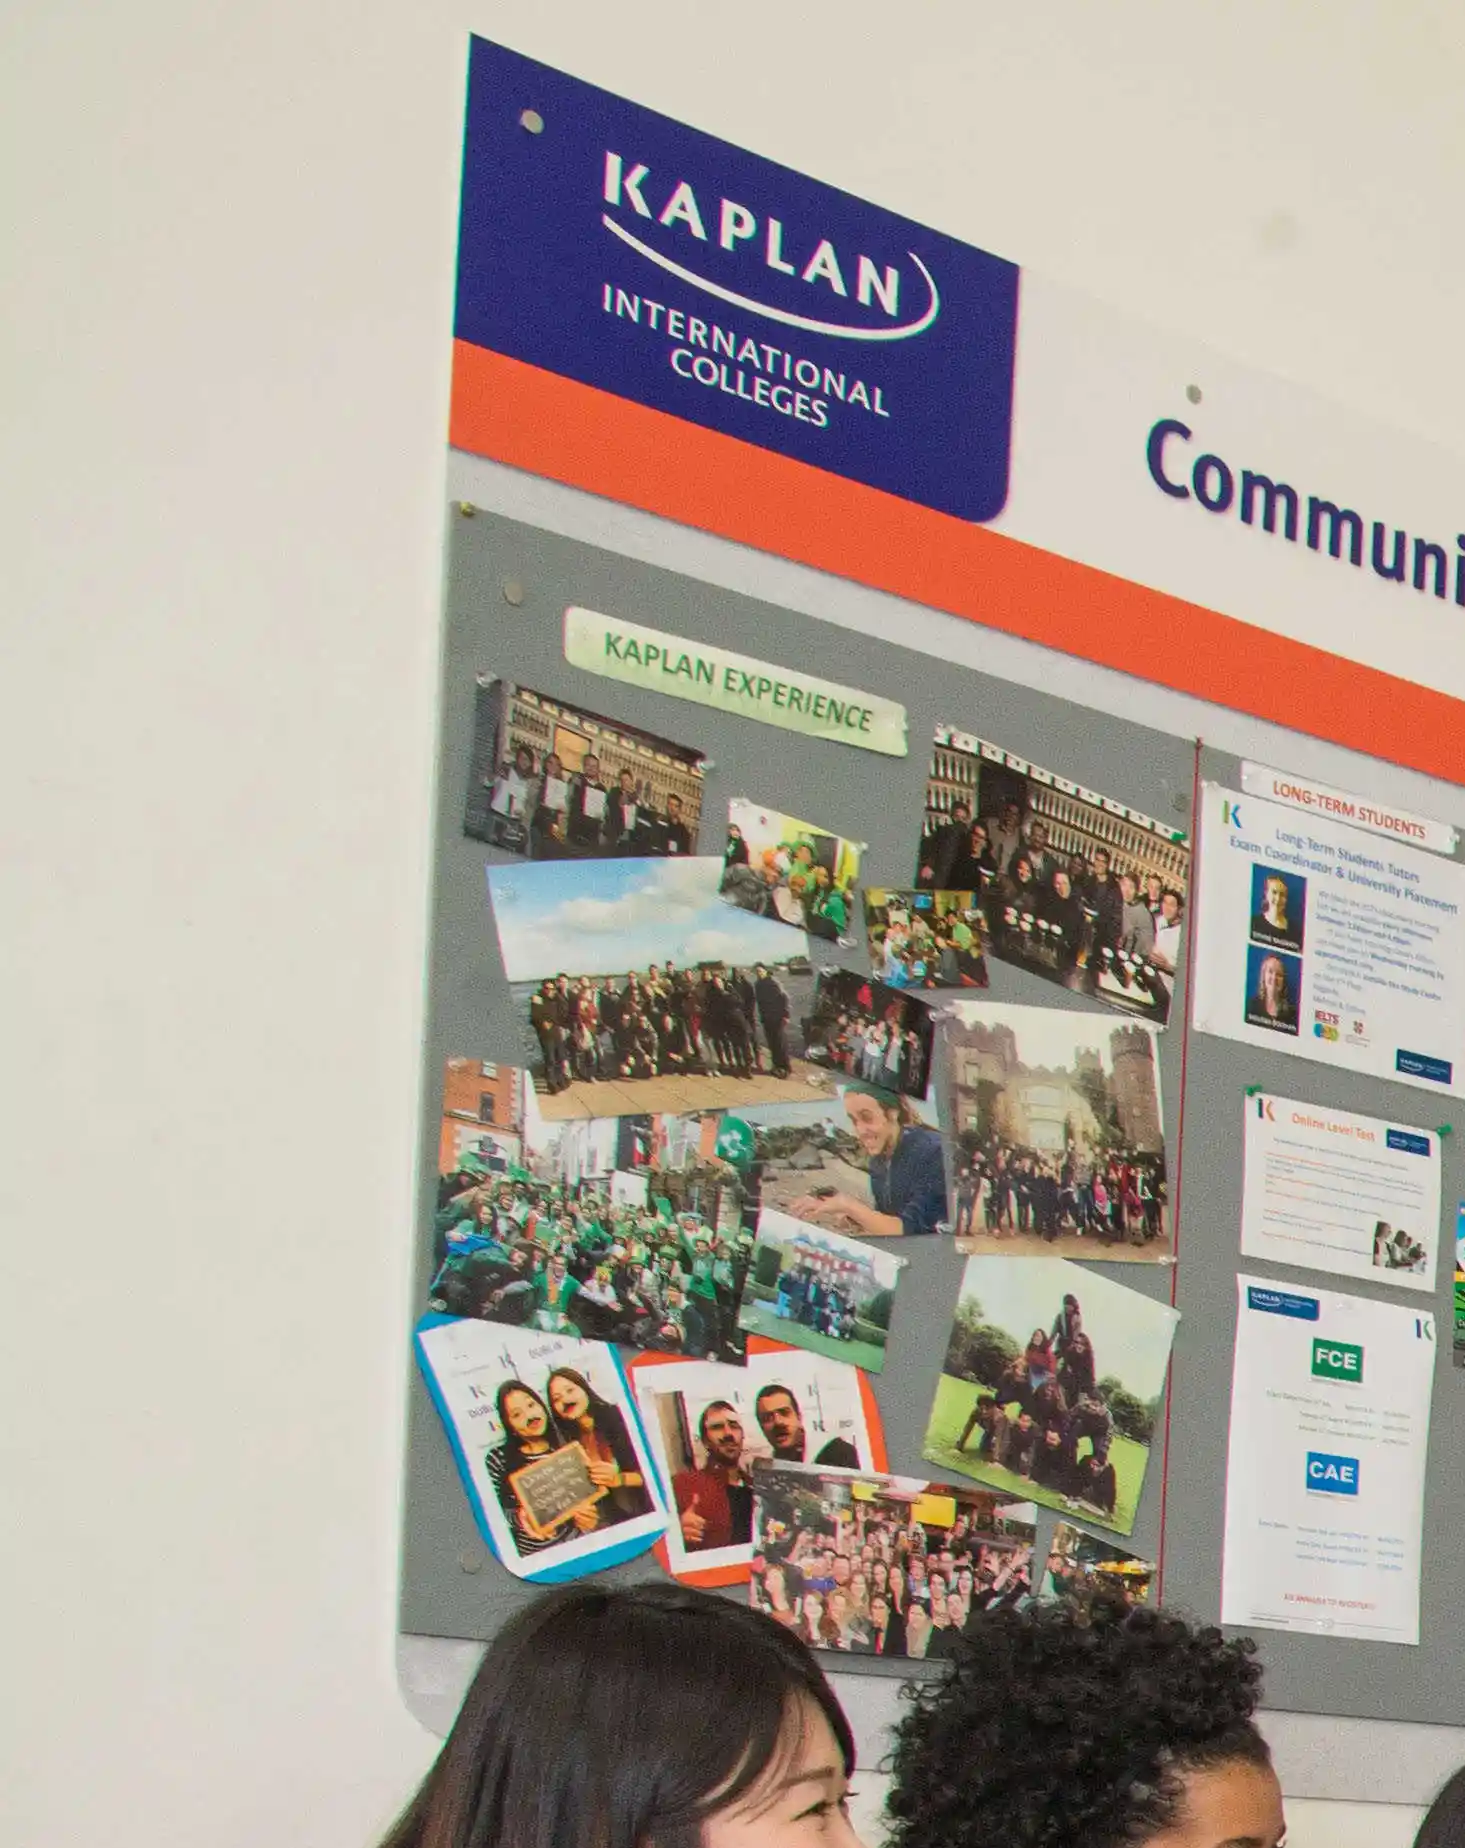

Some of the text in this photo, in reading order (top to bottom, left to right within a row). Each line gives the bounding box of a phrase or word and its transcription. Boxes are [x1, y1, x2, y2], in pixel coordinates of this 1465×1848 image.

[602, 149, 900, 318] KAPLAN
[601, 282, 891, 419] INTERNATIONAL
[669, 346, 829, 429] COLLEGES
[604, 632, 874, 734] KAPLAN EXPERIENCE
[1273, 780, 1426, 839] LONG-TERM STUDENTS
[1230, 836, 1458, 914] Exam Coordinator & University Placement
[1276, 828, 1421, 883] Long-Term Students Tutors
[1291, 1112, 1376, 1142] Online Level Test
[1316, 1347, 1358, 1370] FCE
[1309, 1461, 1354, 1484] CAE
